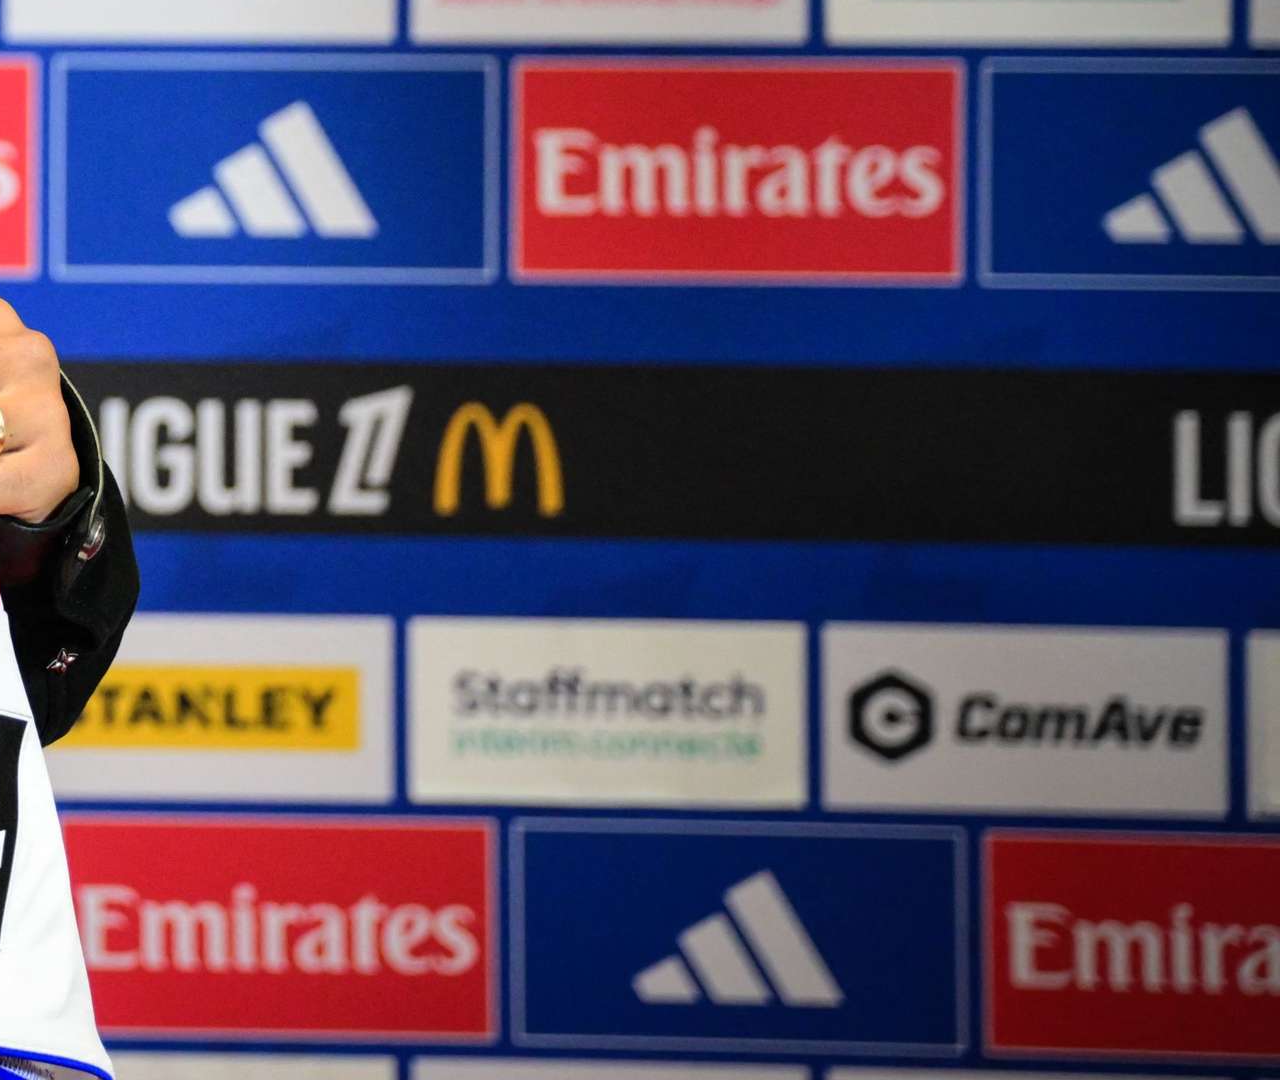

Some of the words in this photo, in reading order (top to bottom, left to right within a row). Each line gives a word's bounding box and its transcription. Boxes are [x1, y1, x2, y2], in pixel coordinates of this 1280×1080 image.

[532, 126, 945, 217] Emirates
[99, 396, 319, 515] IGUE
[78, 682, 336, 732] TANLEY
[453, 667, 768, 720] Staffmatch
[954, 693, 1206, 749] ComAve
[78, 881, 480, 975] Emirates
[1003, 900, 1280, 994] Emira
